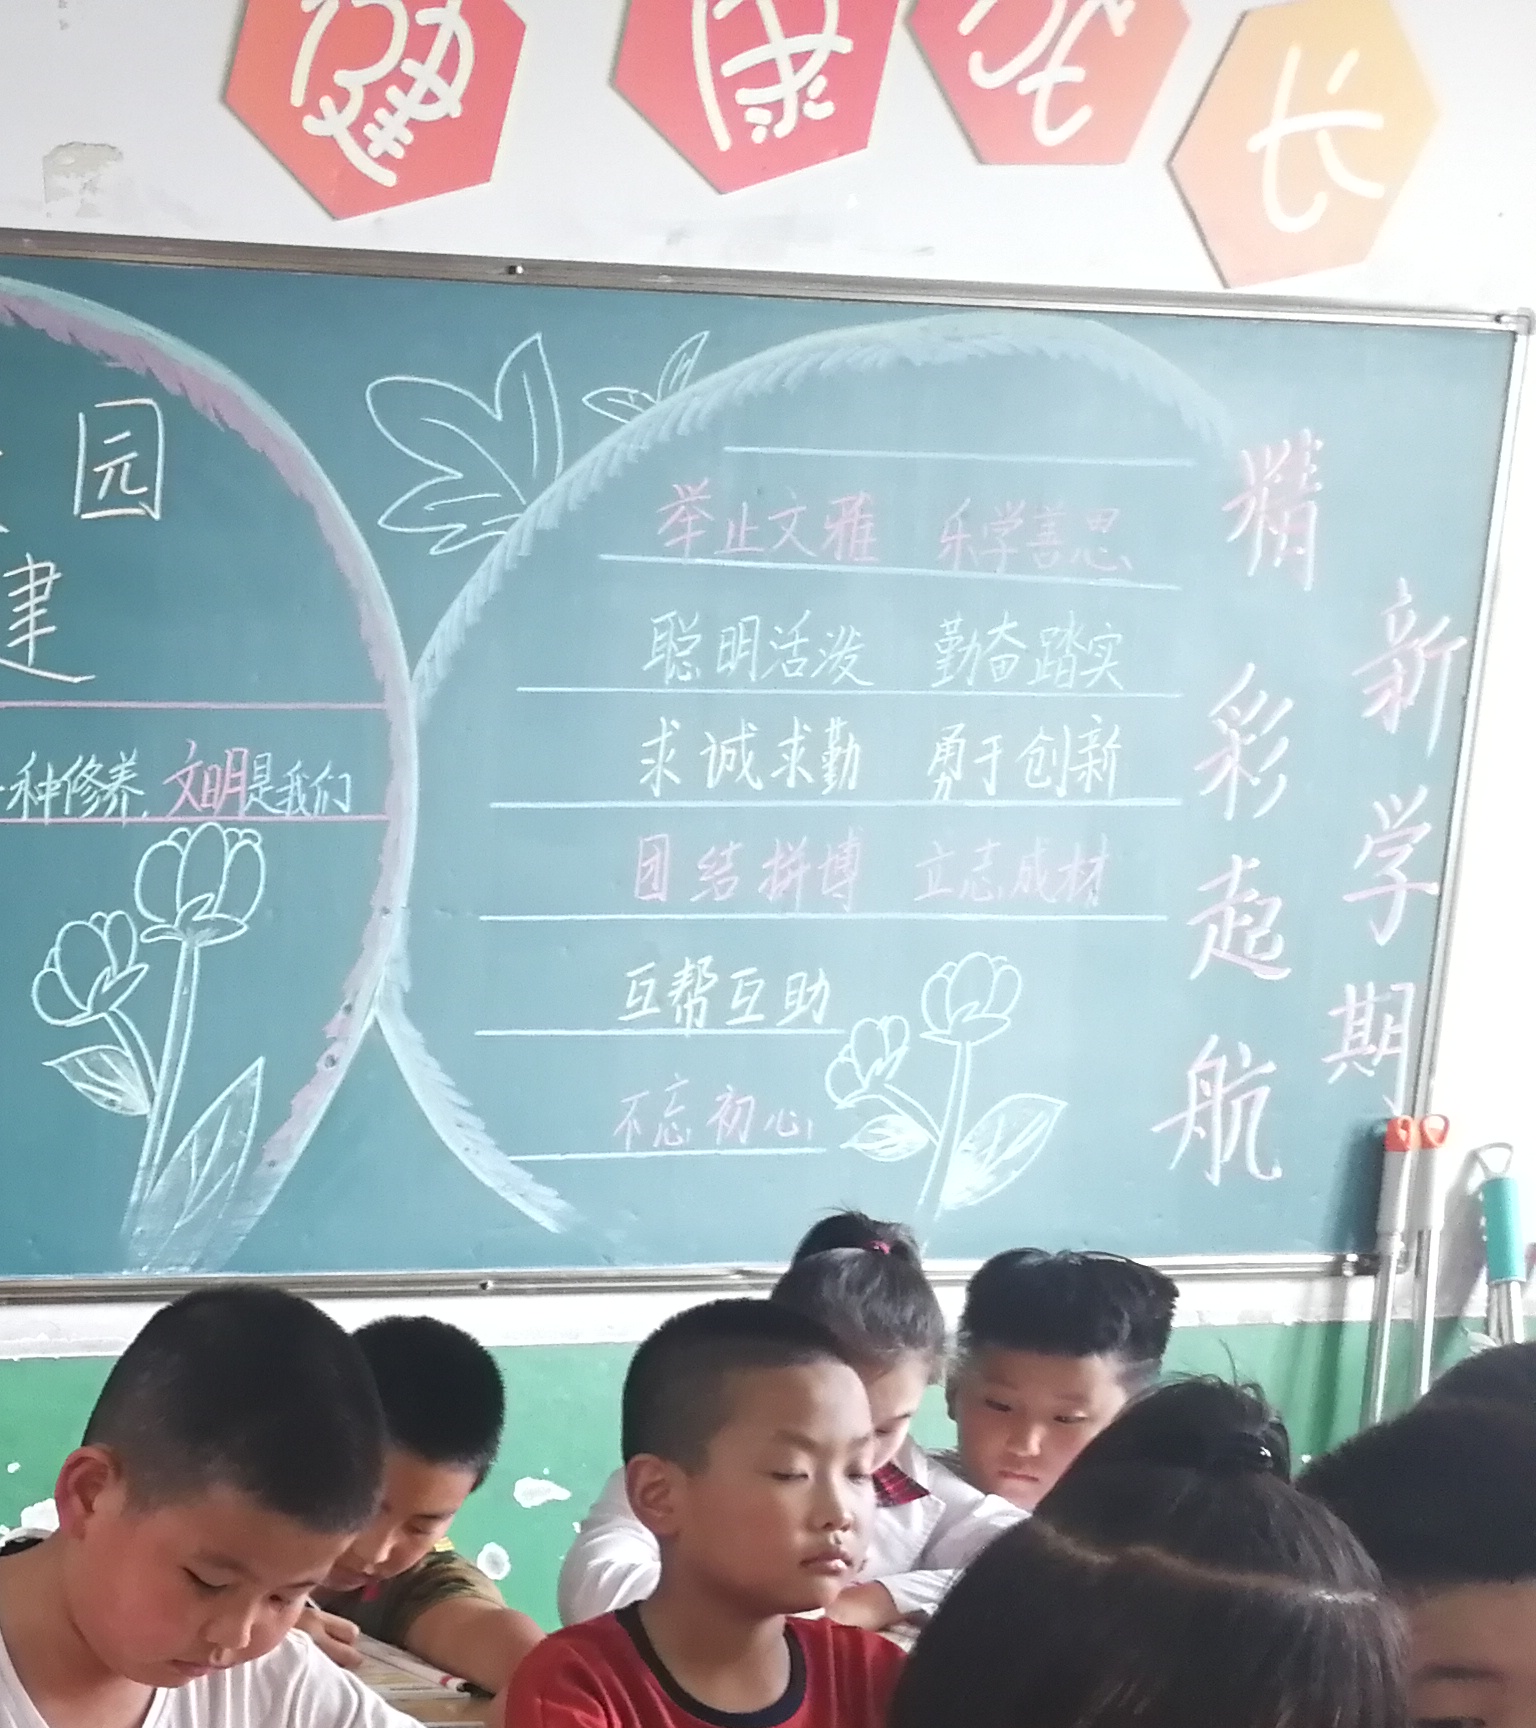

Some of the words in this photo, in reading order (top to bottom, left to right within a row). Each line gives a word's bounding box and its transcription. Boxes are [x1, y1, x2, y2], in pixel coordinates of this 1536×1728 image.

[657, 478, 880, 564] 举止文雅
[643, 609, 875, 687] 聪明活泼
[932, 610, 1125, 690] 勤奋踏实
[638, 716, 862, 799] 求诚求勤
[928, 714, 1123, 801] 勇于创新
[1150, 427, 1324, 1186] 精彩起航
[1321, 577, 1468, 1118] 新学期
[618, 955, 831, 1037] 互帮互助
[613, 1072, 814, 1151] 不忘初心
